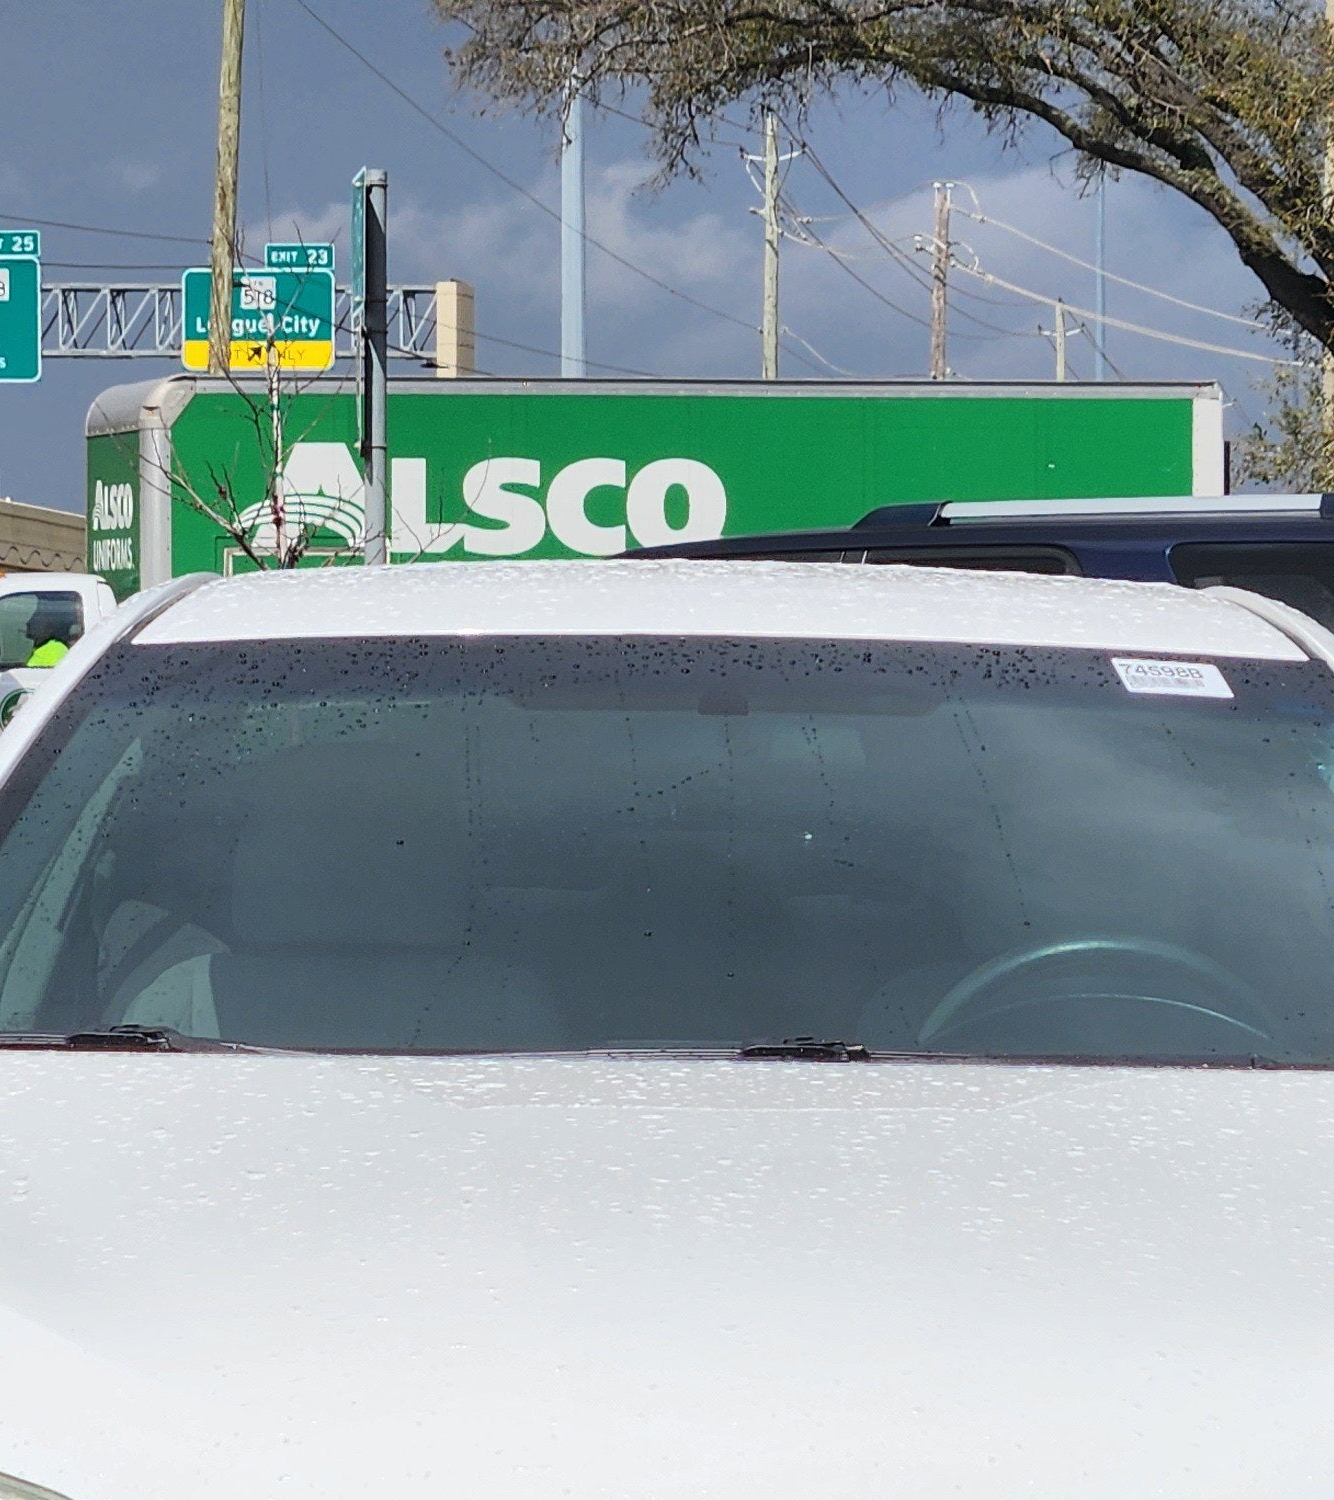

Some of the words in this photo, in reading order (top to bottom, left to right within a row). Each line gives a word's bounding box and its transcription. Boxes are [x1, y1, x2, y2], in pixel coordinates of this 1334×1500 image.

[11, 236, 34, 252] 25
[270, 251, 298, 263] EXIT
[307, 249, 329, 265] 23
[196, 316, 272, 337] Lgue
[281, 314, 320, 337] City
[92, 479, 134, 531] ALSCO
[234, 442, 727, 556] ALSCO
